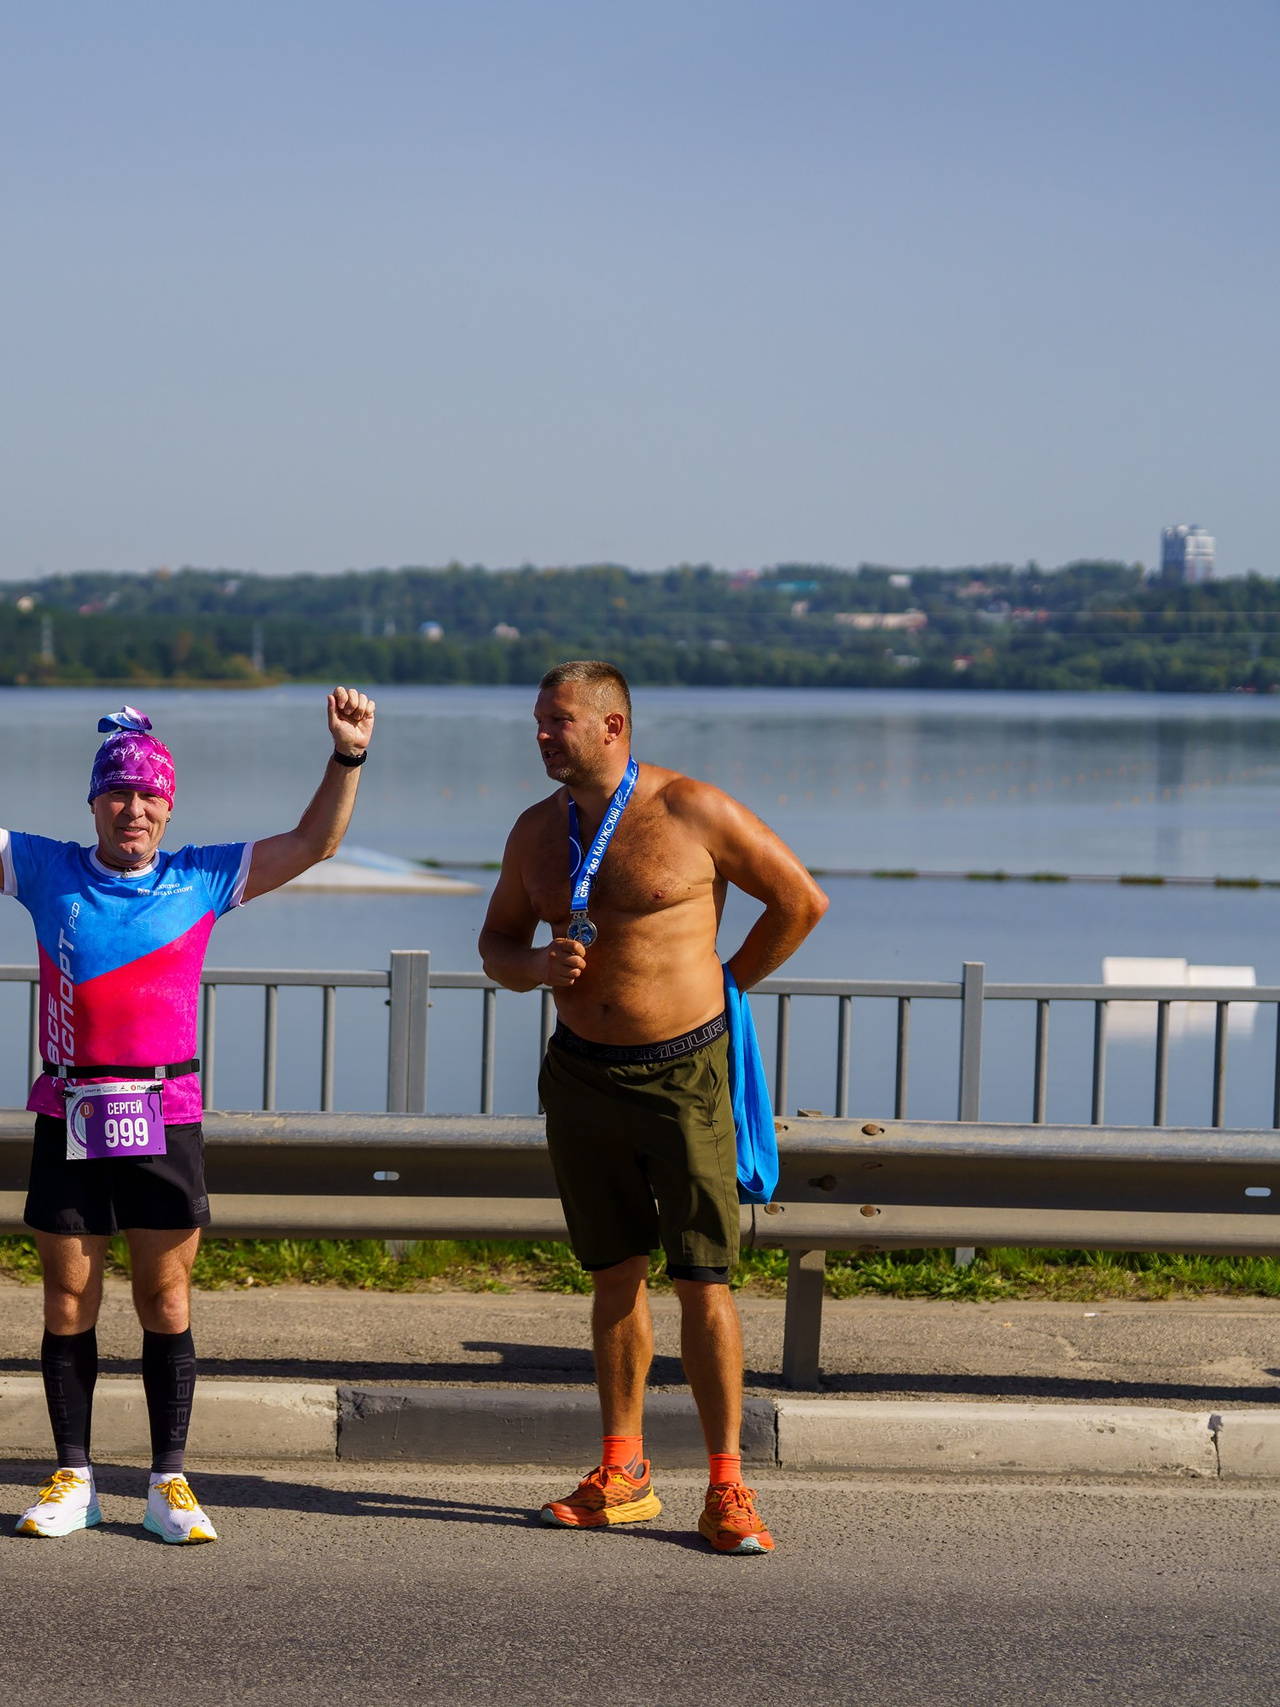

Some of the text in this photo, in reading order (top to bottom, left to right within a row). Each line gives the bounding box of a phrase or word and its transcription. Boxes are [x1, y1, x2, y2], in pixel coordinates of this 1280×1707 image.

[580, 869, 595, 898] СПОРТ
[592, 807, 622, 857] КАЛУЖСКИЙ
[596, 1017, 725, 1061] ARMOUR
[107, 1099, 143, 1115] СЕРГЕЙ
[104, 1117, 150, 1148] 999
